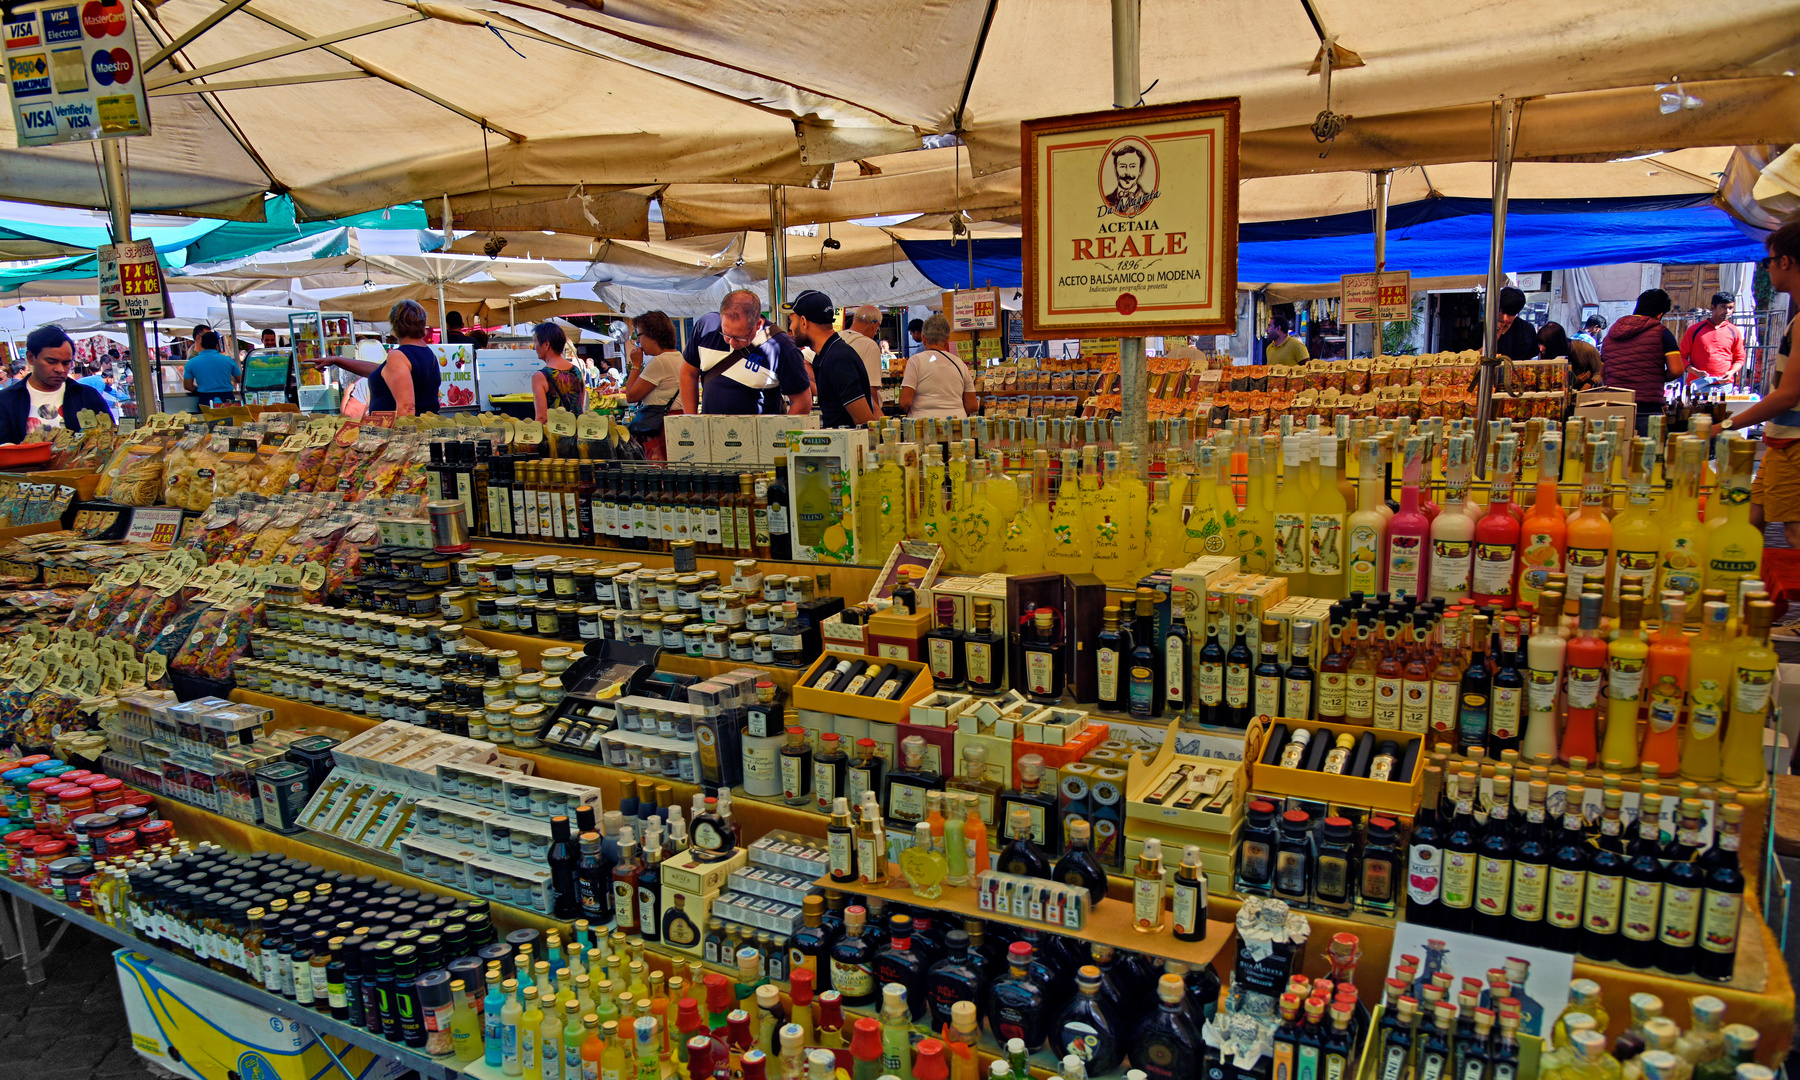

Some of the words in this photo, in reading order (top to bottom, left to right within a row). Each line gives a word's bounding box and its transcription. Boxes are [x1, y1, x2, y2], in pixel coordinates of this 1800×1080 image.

[51, 11, 69, 21] VISA
[84, 12, 125, 25] MasterCard
[10, 22, 33, 38] VISA
[48, 29, 79, 39] Electron
[10, 58, 35, 77] Pago
[96, 62, 129, 73] Maestro
[13, 78, 49, 89] BANCOMAT
[55, 104, 83, 116] Verified
[85, 106, 93, 115] by
[22, 110, 54, 128] VISA
[66, 115, 90, 128] VISA
[1097, 204, 1114, 218] Da
[1098, 220, 1159, 234] ACETAIA
[1071, 232, 1188, 261] REALE
[124, 265, 130, 278] 1
[134, 265, 141, 278] X
[145, 263, 155, 276] 4€
[1117, 259, 1142, 271] 1896
[1058, 276, 1088, 287] ACETO
[1090, 272, 1145, 285] BALSAMICO
[1157, 269, 1201, 281] MODENA
[1346, 276, 1384, 288] PASTA
[125, 281, 132, 294] 3
[134, 280, 142, 293] X
[144, 279, 158, 293] 10€
[1089, 285, 1118, 293] Indicazione
[1119, 284, 1146, 293] geografica
[1147, 282, 1168, 291] protetta
[125, 299, 142, 307] Made
[143, 298, 148, 306] in
[130, 307, 146, 318] Italy
[453, 372, 471, 381] JUICE
[1057, 508, 1077, 517] Roma
[1096, 537, 1118, 548] Roma
[1711, 560, 1756, 570] PALLINI
[1412, 865, 1437, 873] MELA
